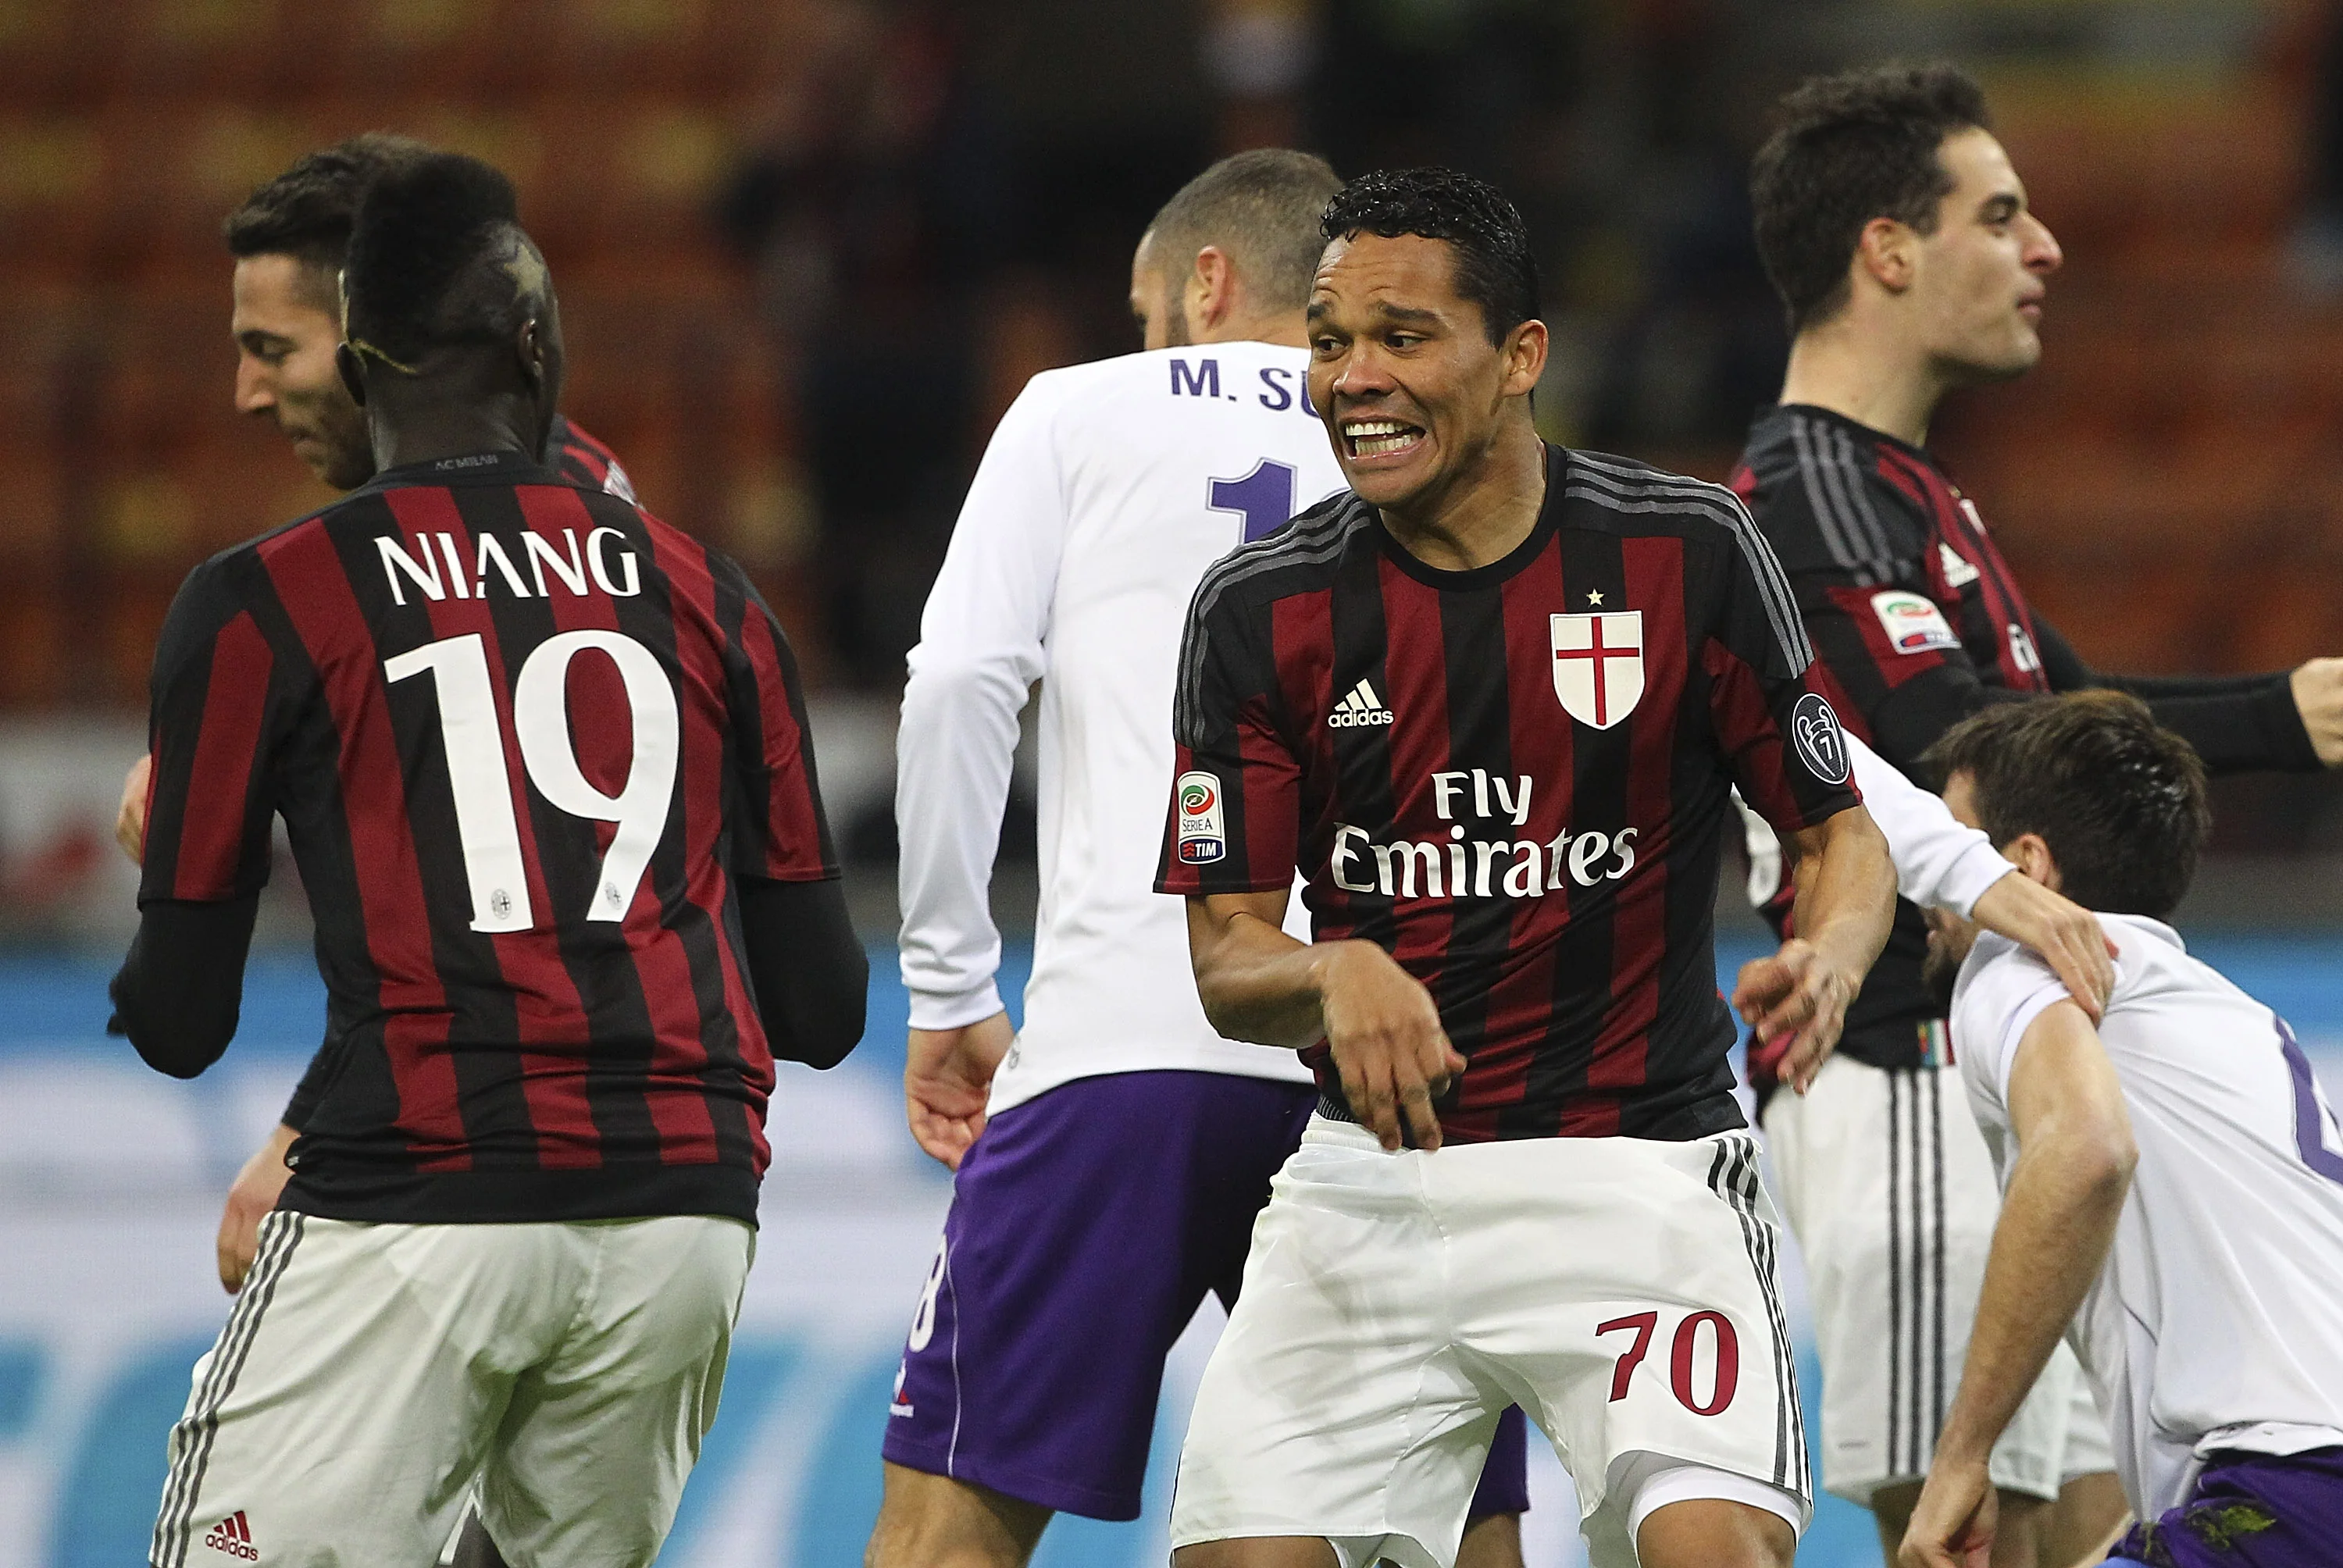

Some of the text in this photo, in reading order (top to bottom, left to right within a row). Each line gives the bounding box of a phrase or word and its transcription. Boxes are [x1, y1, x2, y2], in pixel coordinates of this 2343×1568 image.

[1169, 358, 1237, 401] M.
[435, 459, 455, 470] AC
[373, 526, 641, 606] NIANG
[1328, 708, 1394, 728] adidas
[383, 629, 680, 933] 19
[1431, 768, 1533, 826] Fly
[1182, 817, 1214, 832] SERIE A
[1195, 842, 1217, 857] TIM
[1331, 821, 1639, 899] Emirates
[1595, 1310, 1739, 1417] 70
[205, 1534, 259, 1562] adidas
